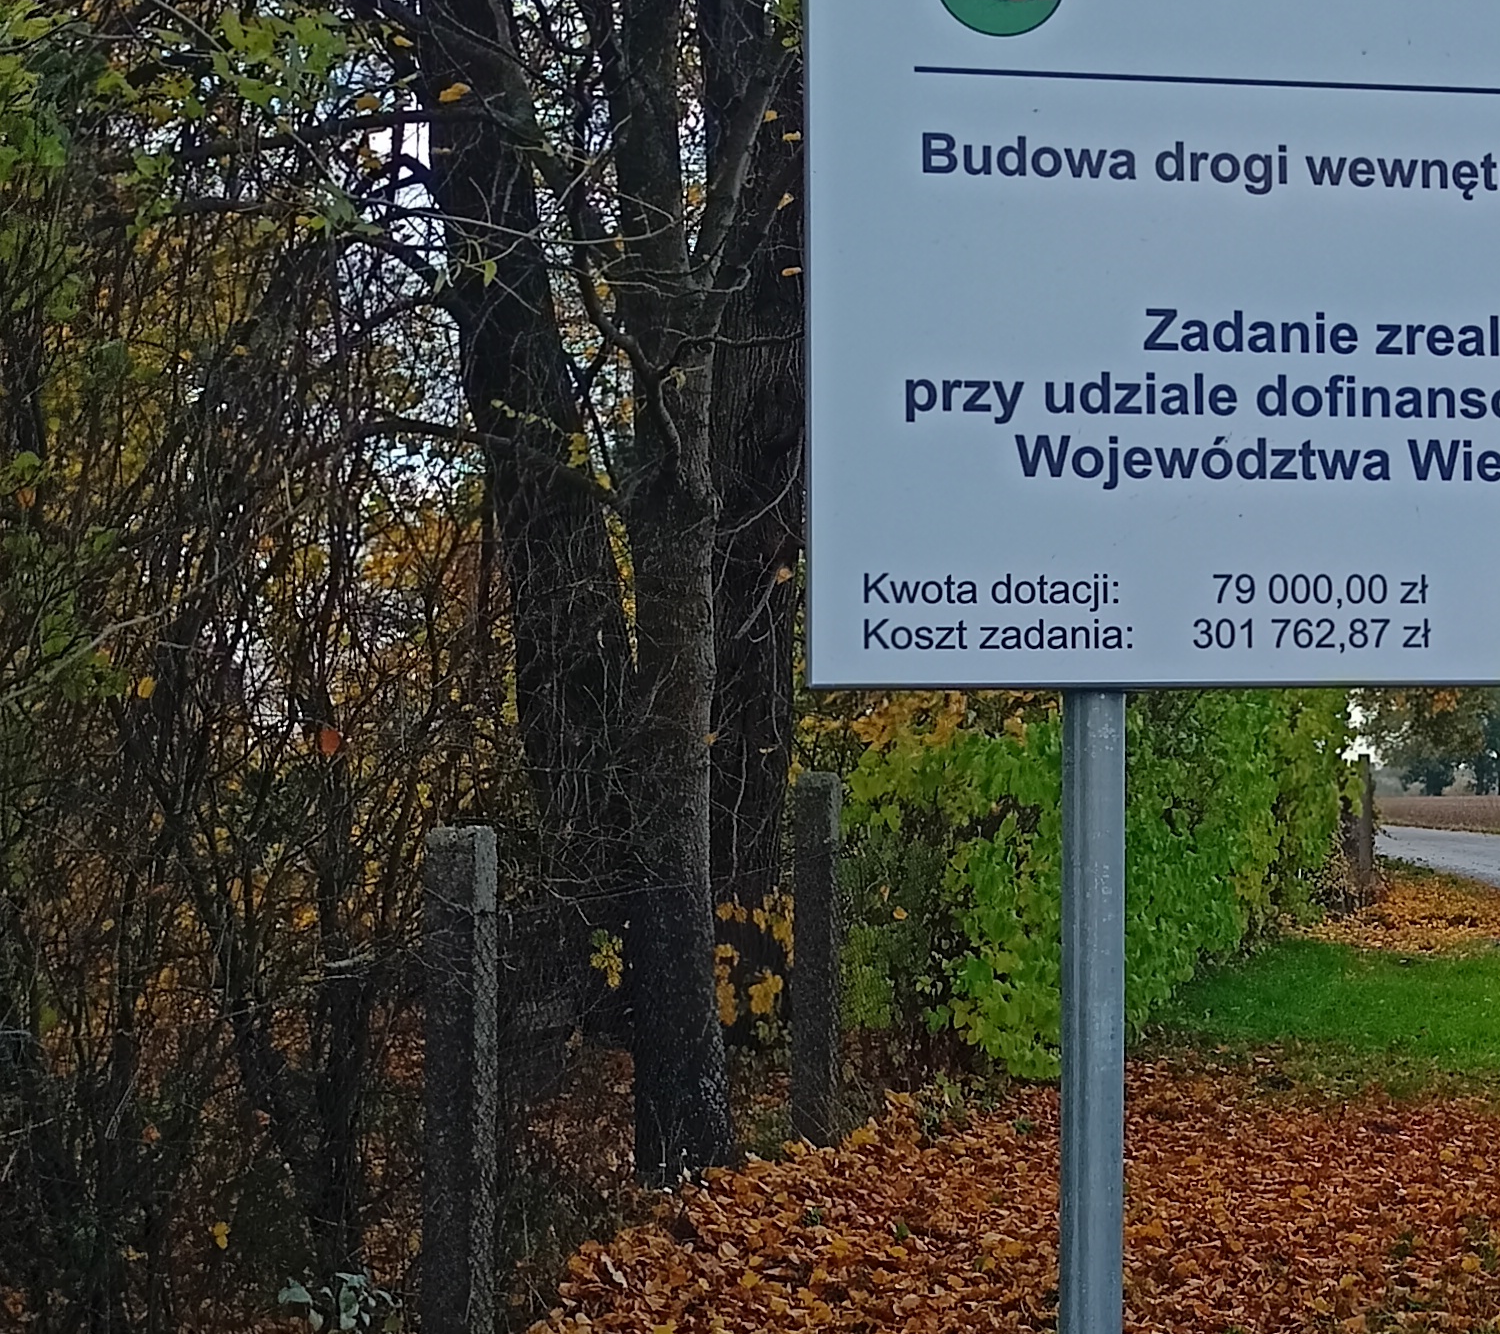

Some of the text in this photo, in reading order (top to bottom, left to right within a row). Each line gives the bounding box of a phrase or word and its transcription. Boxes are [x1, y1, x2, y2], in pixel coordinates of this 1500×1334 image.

[922, 132, 1136, 180] Budowa
[1155, 141, 1287, 195] drogi
[1144, 308, 1358, 354] Zadanie
[906, 379, 1024, 424] przy
[1045, 371, 1237, 416] udziale
[1015, 434, 1390, 490] Województwa
[864, 573, 1428, 612] Kwota dotacji: 79 000,00 zł
[864, 618, 1431, 653] Koszt zadania: 301 762,87 zł
